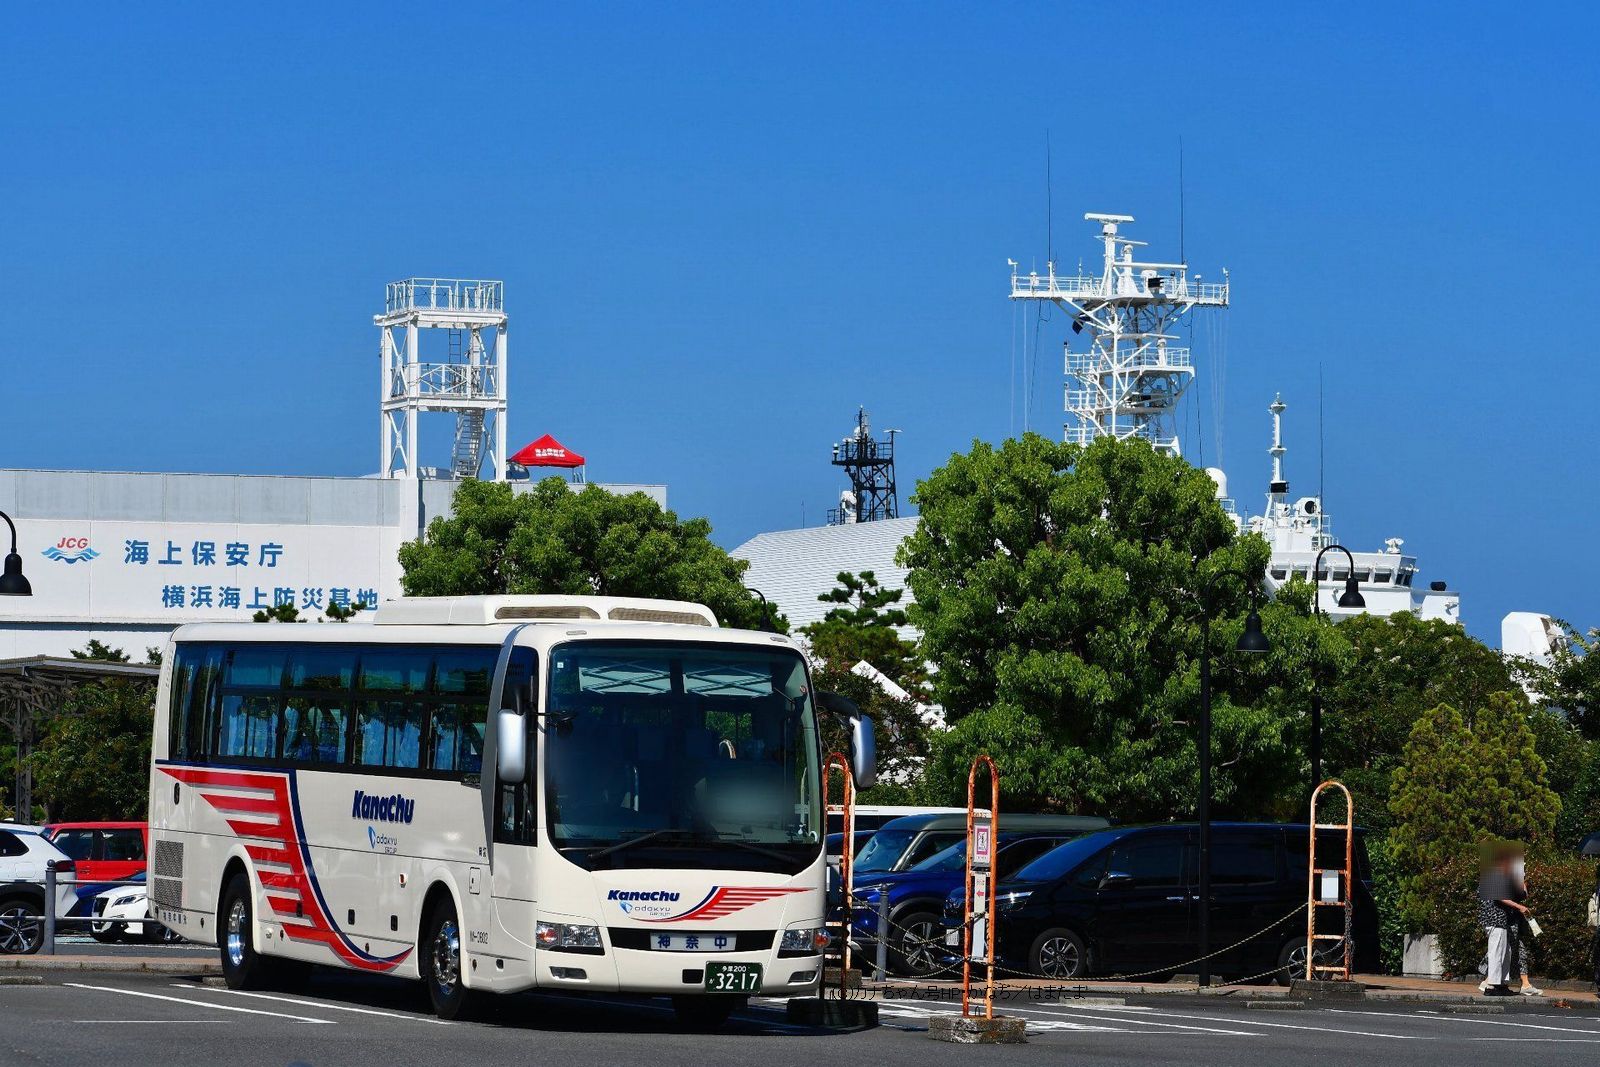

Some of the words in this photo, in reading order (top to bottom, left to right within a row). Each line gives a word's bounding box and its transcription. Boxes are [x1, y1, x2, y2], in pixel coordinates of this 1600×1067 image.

[57, 537, 88, 549] JCG
[124, 540, 284, 568] 海上保安庁
[162, 585, 379, 611] 横浜海上防災基地
[352, 789, 415, 824] Kanachu
[607, 889, 681, 902] Kanachu
[657, 934, 728, 949] 神奈中
[715, 972, 759, 990] 32-17
